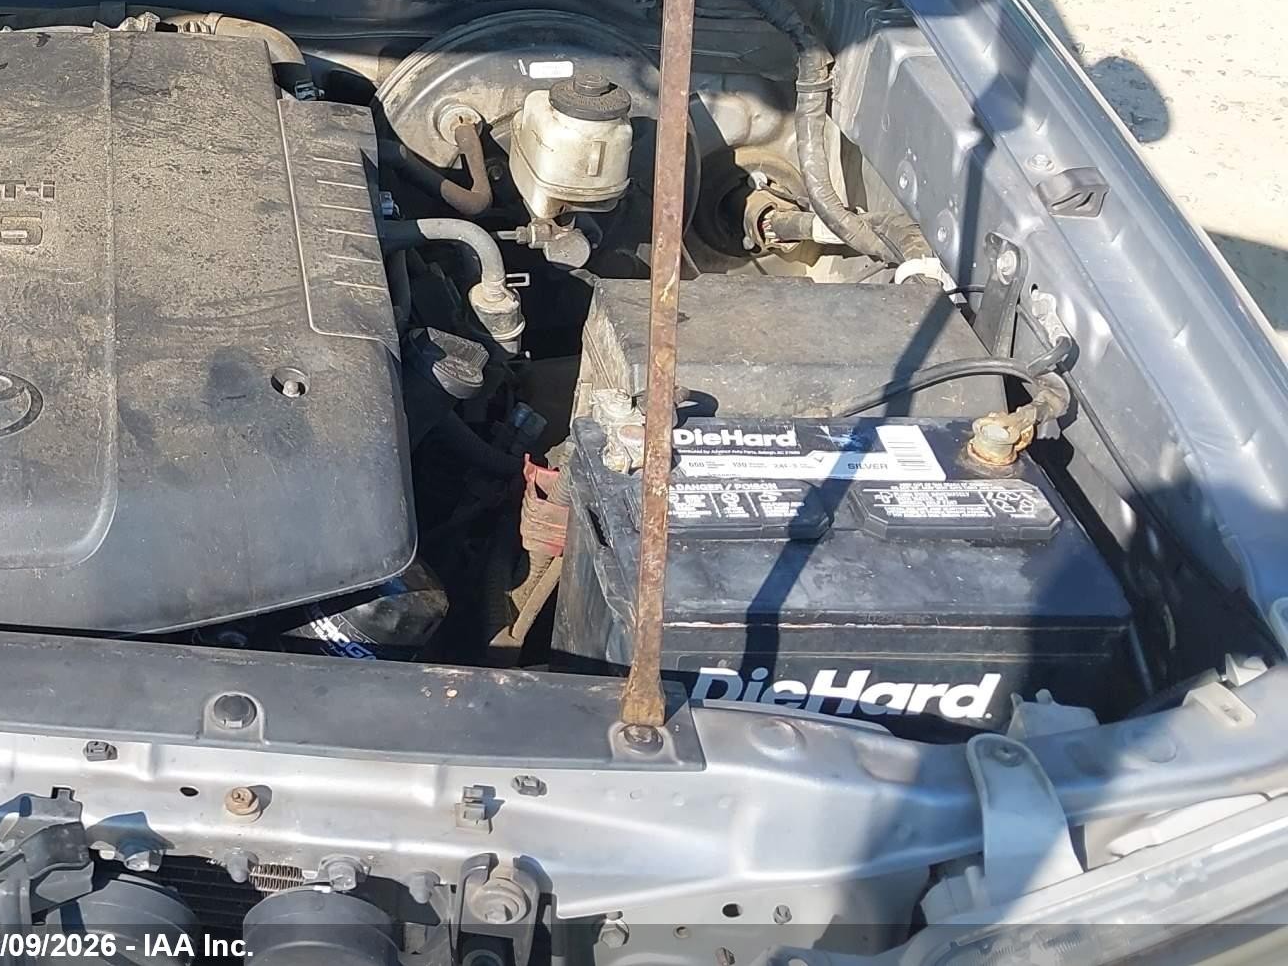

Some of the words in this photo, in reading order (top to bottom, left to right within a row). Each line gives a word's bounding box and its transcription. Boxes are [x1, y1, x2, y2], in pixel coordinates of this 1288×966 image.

[672, 427, 797, 447] DieHard
[847, 462, 888, 470] SILVER
[675, 483, 722, 491] DANGER
[733, 482, 778, 490] POISON
[688, 667, 1002, 719] DieHard
